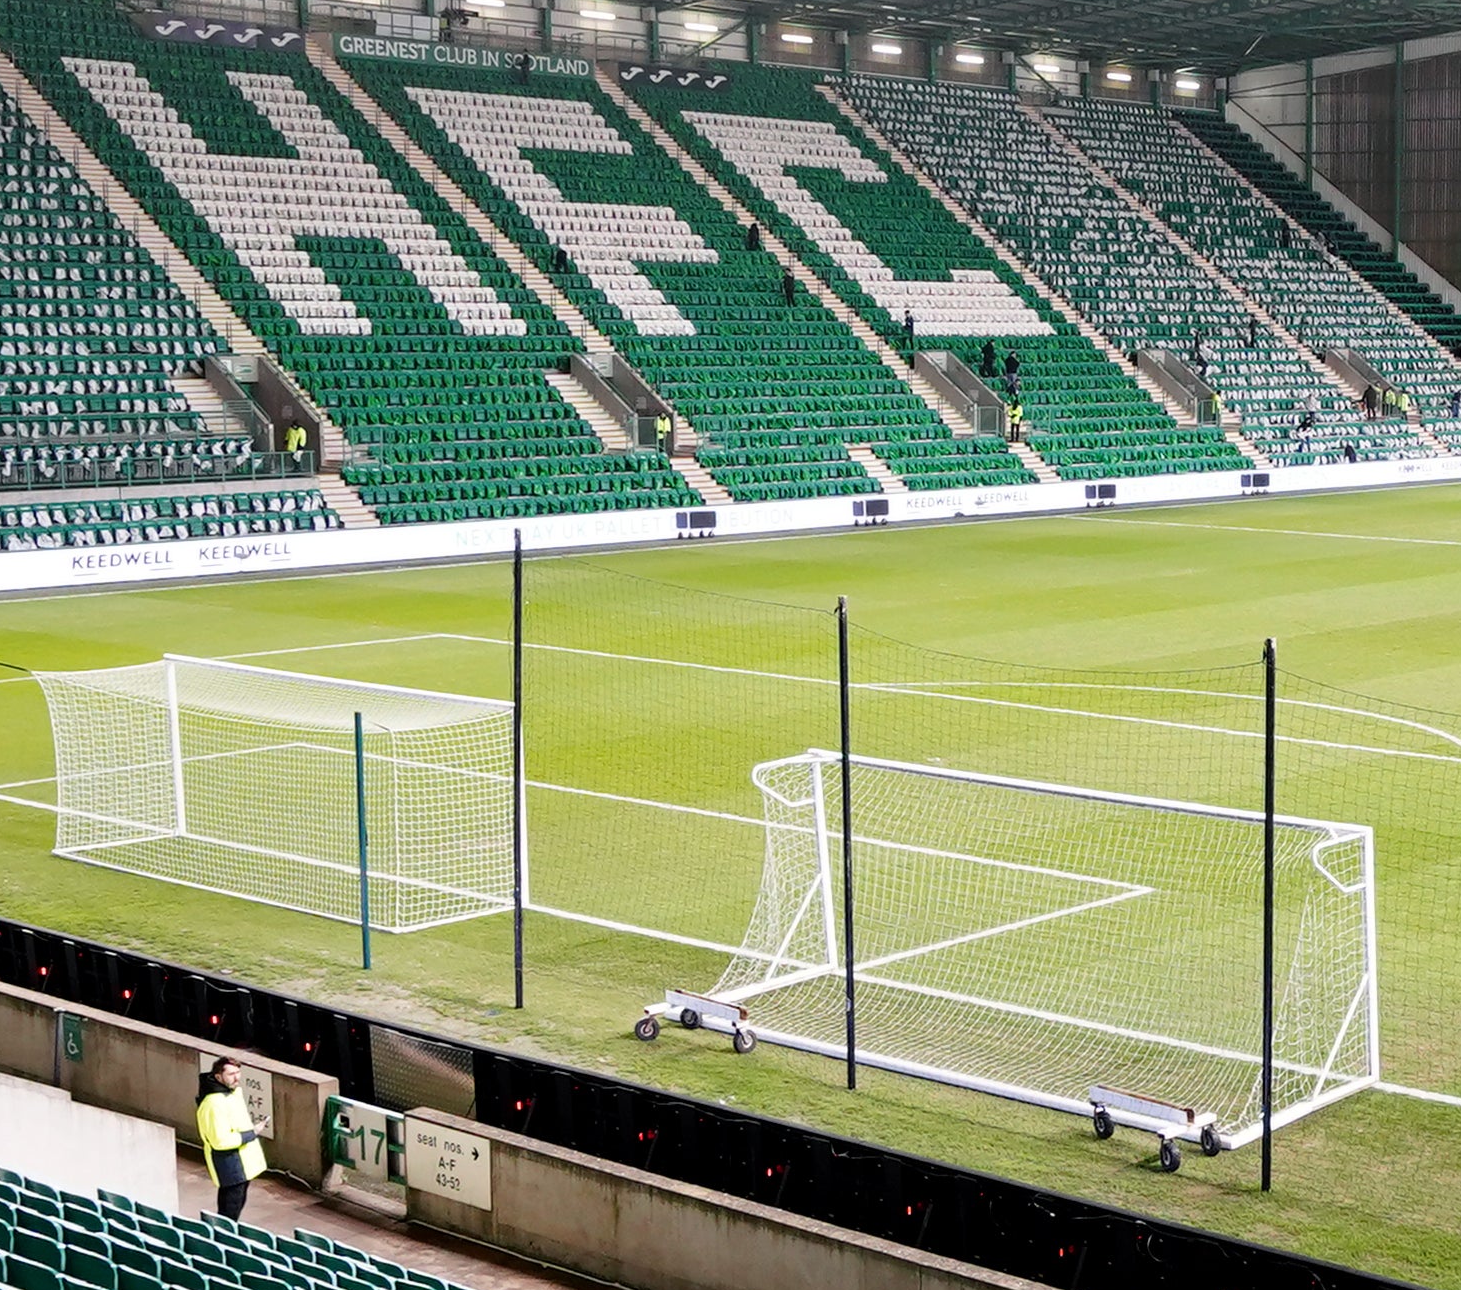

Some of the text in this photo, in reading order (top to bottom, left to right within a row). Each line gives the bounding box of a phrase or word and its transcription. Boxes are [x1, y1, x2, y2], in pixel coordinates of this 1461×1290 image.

[339, 36, 589, 76] GREENEST CLUB IN SCOTLAND
[906, 495, 963, 509] KEEDWELL
[199, 542, 292, 560] KEEDWELL
[72, 551, 174, 570] KEEDWELL
[245, 1077, 264, 1091] nos.
[247, 1094, 264, 1109] A-F
[354, 1125, 386, 1165] 17
[416, 1132, 465, 1156] seat nos.
[438, 1156, 458, 1171] A-F
[435, 1172, 461, 1193] 43-52
